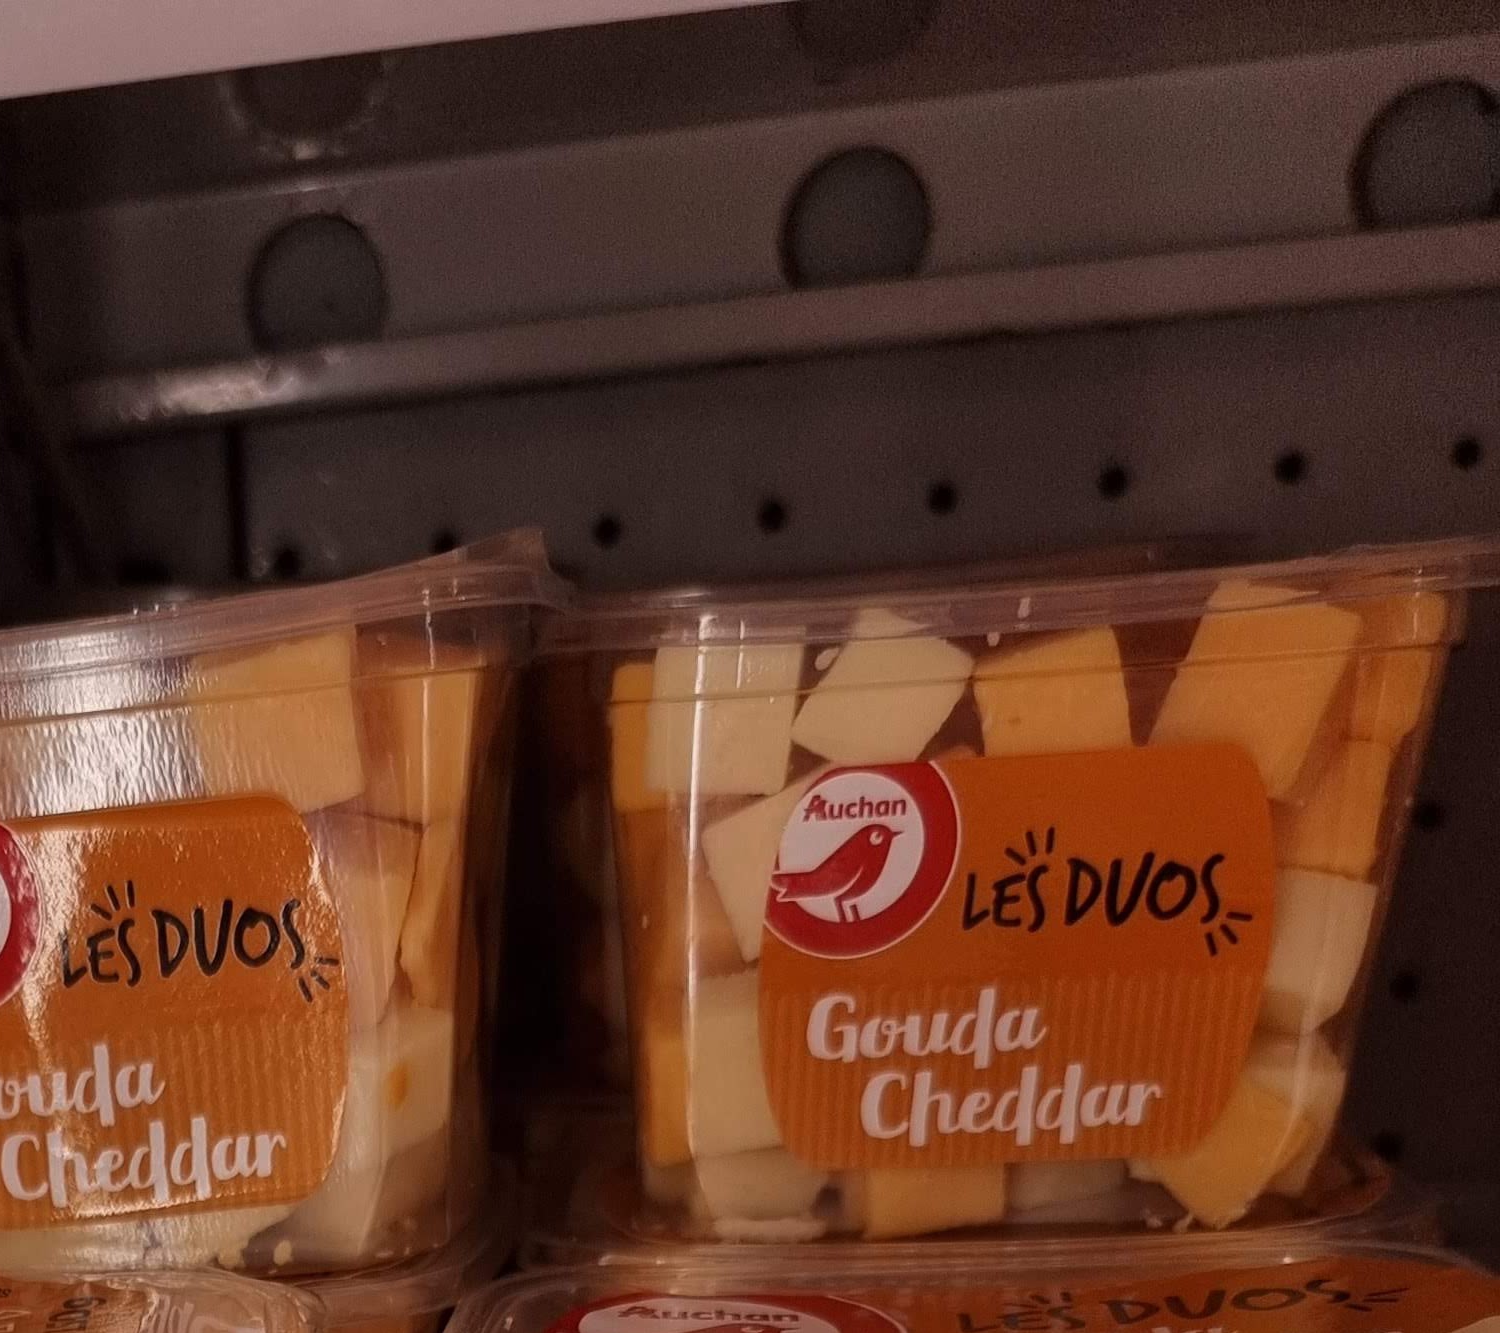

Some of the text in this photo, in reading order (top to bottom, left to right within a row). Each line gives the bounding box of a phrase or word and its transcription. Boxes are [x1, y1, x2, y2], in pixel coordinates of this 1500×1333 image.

[802, 795, 907, 823] Auchan
[962, 851, 1224, 932] LES DUOS
[60, 899, 307, 988] LES DUOS
[807, 987, 1048, 1069] Gouda
[860, 1065, 1163, 1146] Cheddar
[1, 1116, 285, 1208] Cheddar
[616, 1305, 800, 1323] Auchan
[957, 1279, 1350, 1333] LES DUOS
